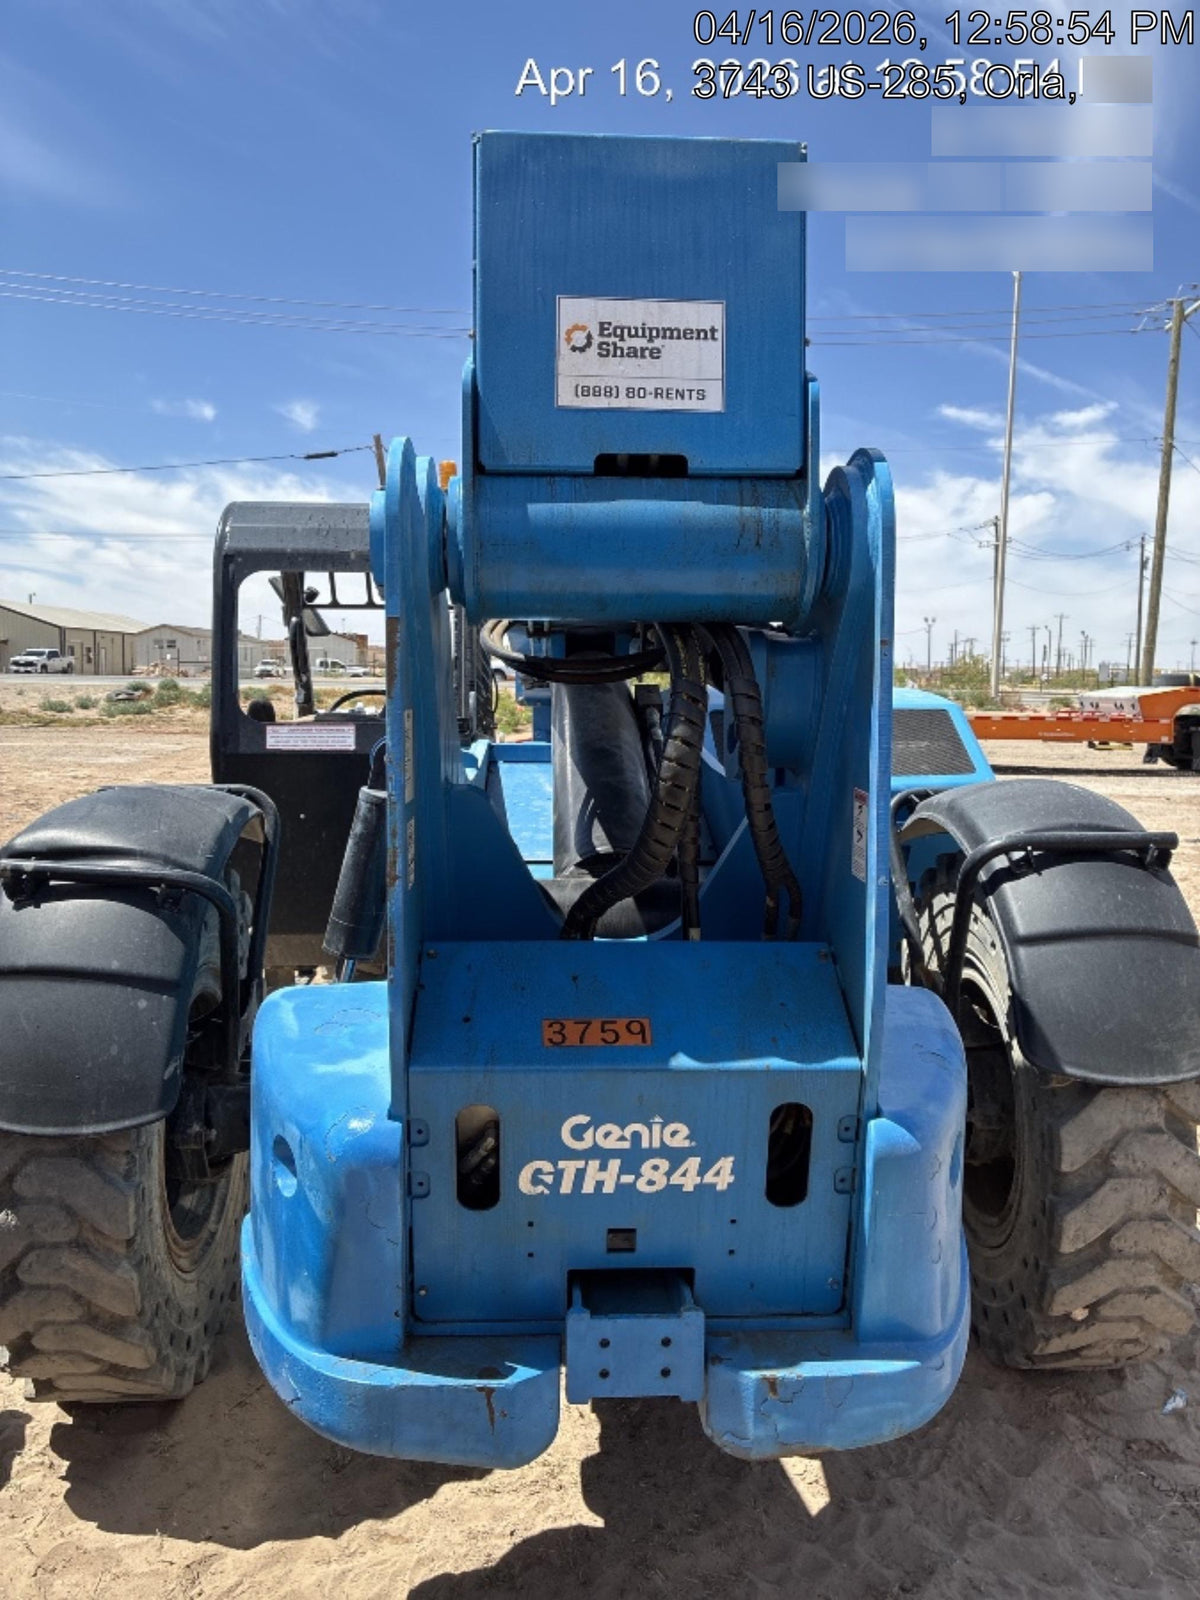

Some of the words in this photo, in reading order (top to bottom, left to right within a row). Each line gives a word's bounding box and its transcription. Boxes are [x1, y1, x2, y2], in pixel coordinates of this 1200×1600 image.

[597, 321, 719, 342] Equipment
[597, 341, 663, 360] Share
[574, 383, 620, 399] (888)
[625, 386, 707, 401] 80-RENTS
[546, 1019, 648, 1046] 3759
[560, 1113, 692, 1151] Genie
[517, 1156, 736, 1196] GTH-844
